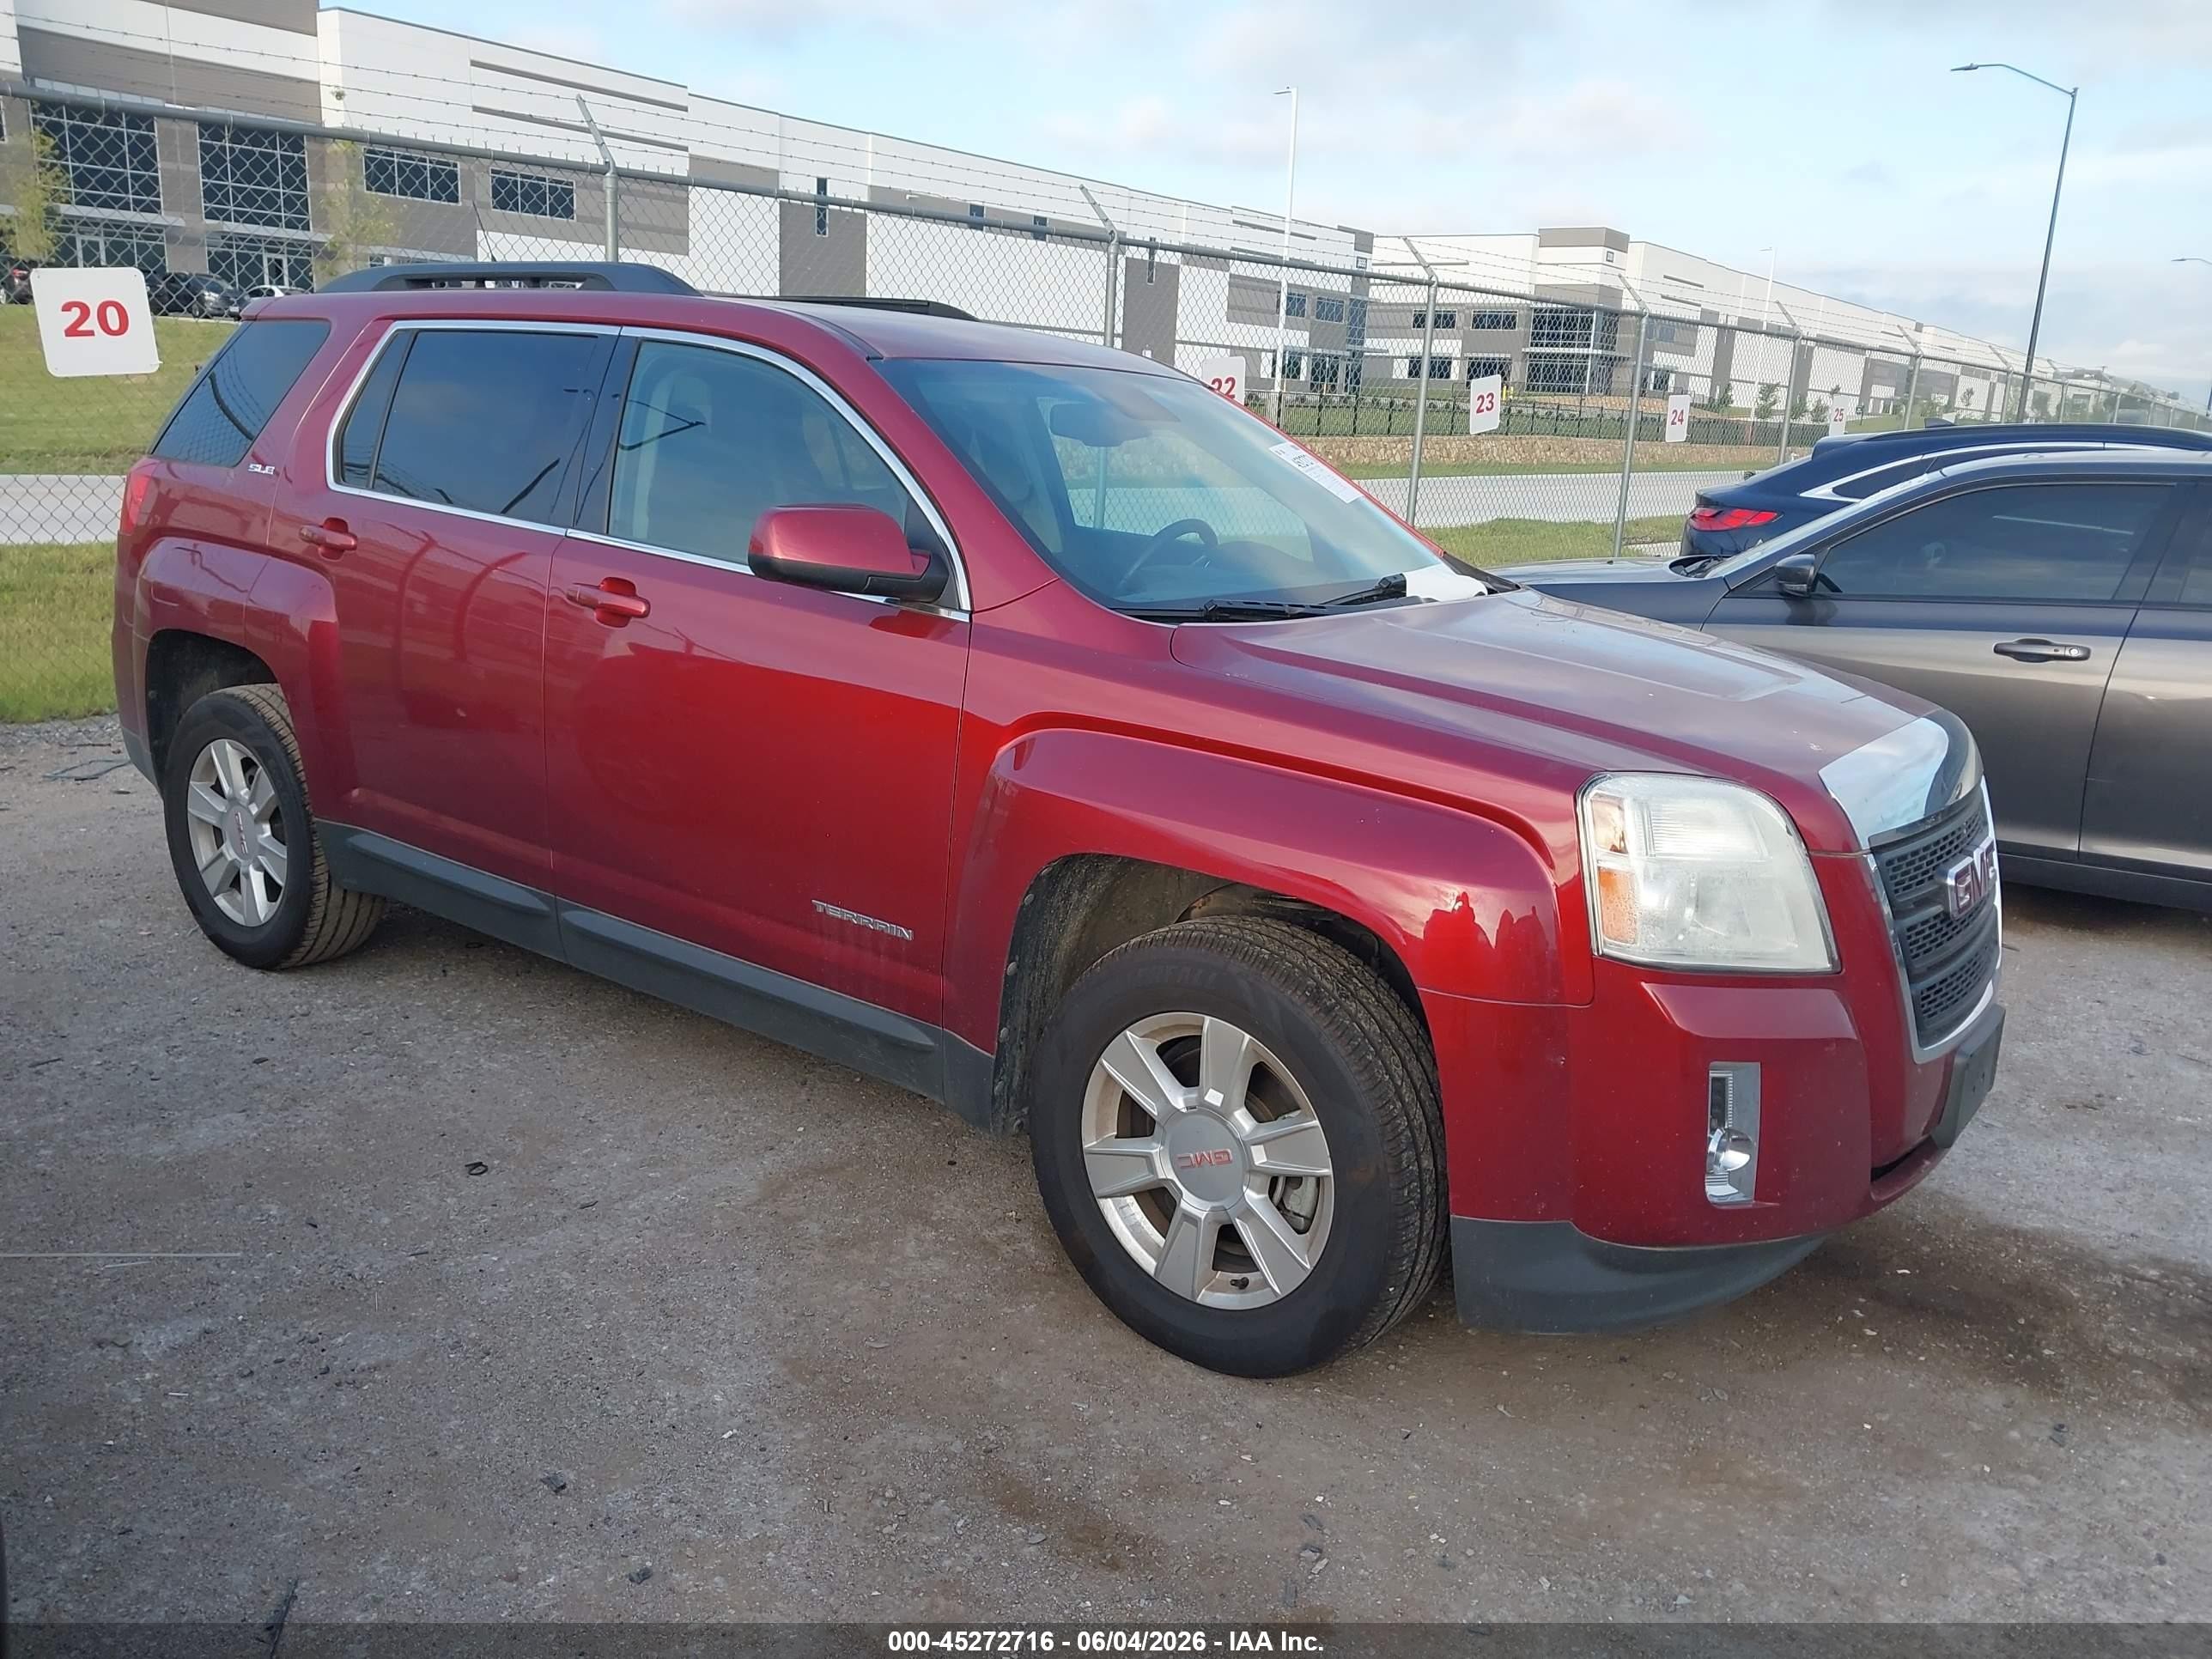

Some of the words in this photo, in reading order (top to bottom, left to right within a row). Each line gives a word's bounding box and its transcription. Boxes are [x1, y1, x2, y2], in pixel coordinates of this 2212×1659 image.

[61, 300, 130, 337] 20
[1211, 376, 1237, 399] 22
[1476, 392, 1495, 414] 23
[1670, 409, 1685, 426] 24
[1833, 407, 1844, 422] 25
[1947, 836, 1996, 921] GMC
[811, 899, 914, 941] TERRAIN
[1176, 1148, 1234, 1170] GMC
